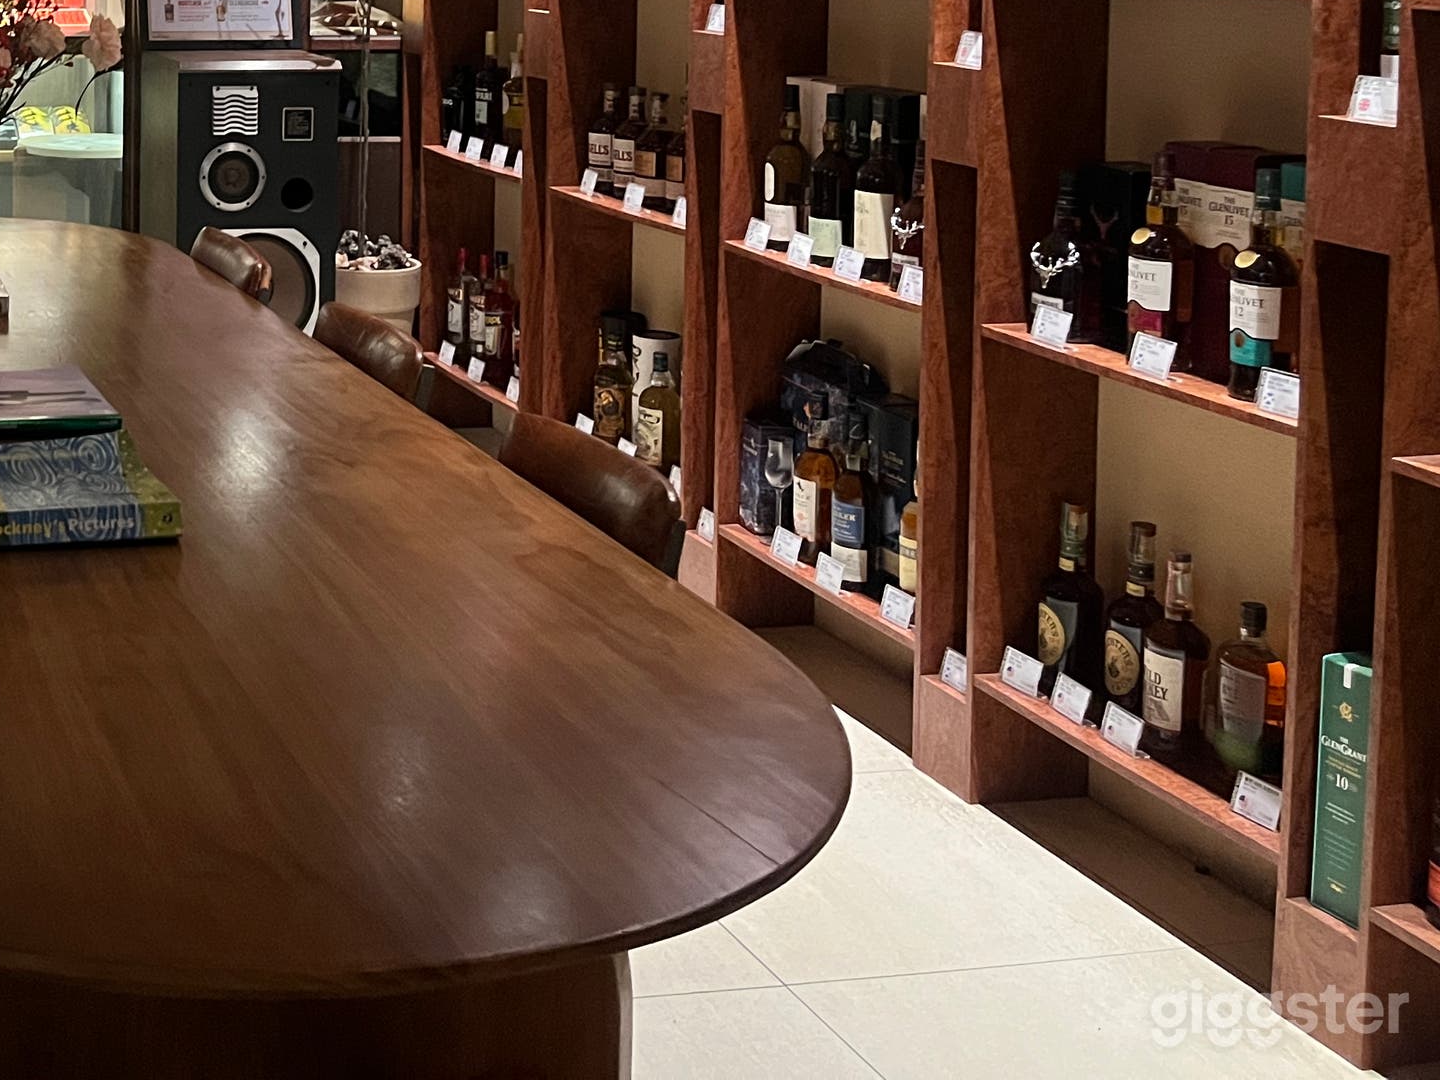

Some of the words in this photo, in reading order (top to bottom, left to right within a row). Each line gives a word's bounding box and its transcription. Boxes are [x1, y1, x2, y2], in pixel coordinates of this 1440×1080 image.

[1208, 201, 1251, 218] GLENLIVET
[1224, 215, 1234, 226] 15
[68, 517, 135, 532] Pictures
[1336, 774, 1349, 791] 10
